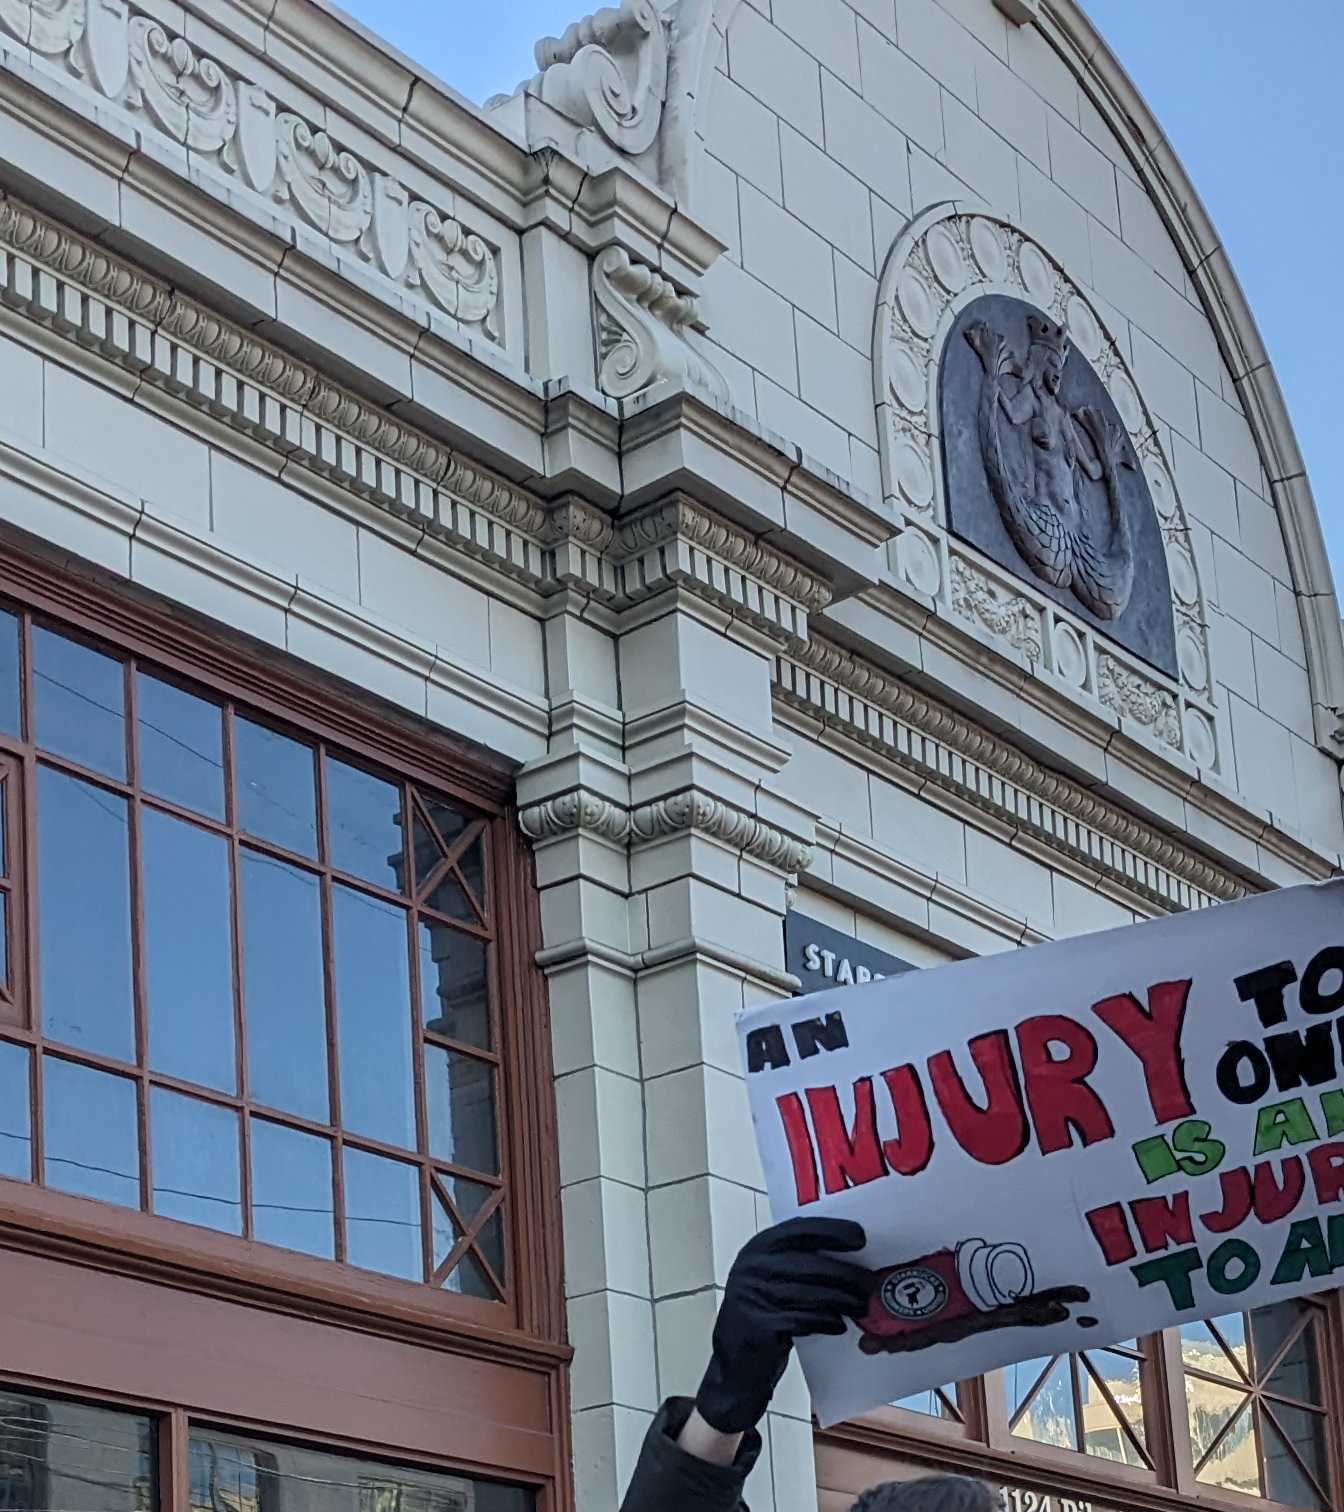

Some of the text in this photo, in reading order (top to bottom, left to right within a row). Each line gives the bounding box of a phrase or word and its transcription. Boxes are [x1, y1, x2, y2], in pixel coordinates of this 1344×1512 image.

[805, 943, 886, 985] STAR
[746, 1011, 850, 1074] AN
[776, 978, 1197, 1207] INJURY
[1133, 1119, 1225, 1184] IS
[1129, 1237, 1261, 1310] TO
